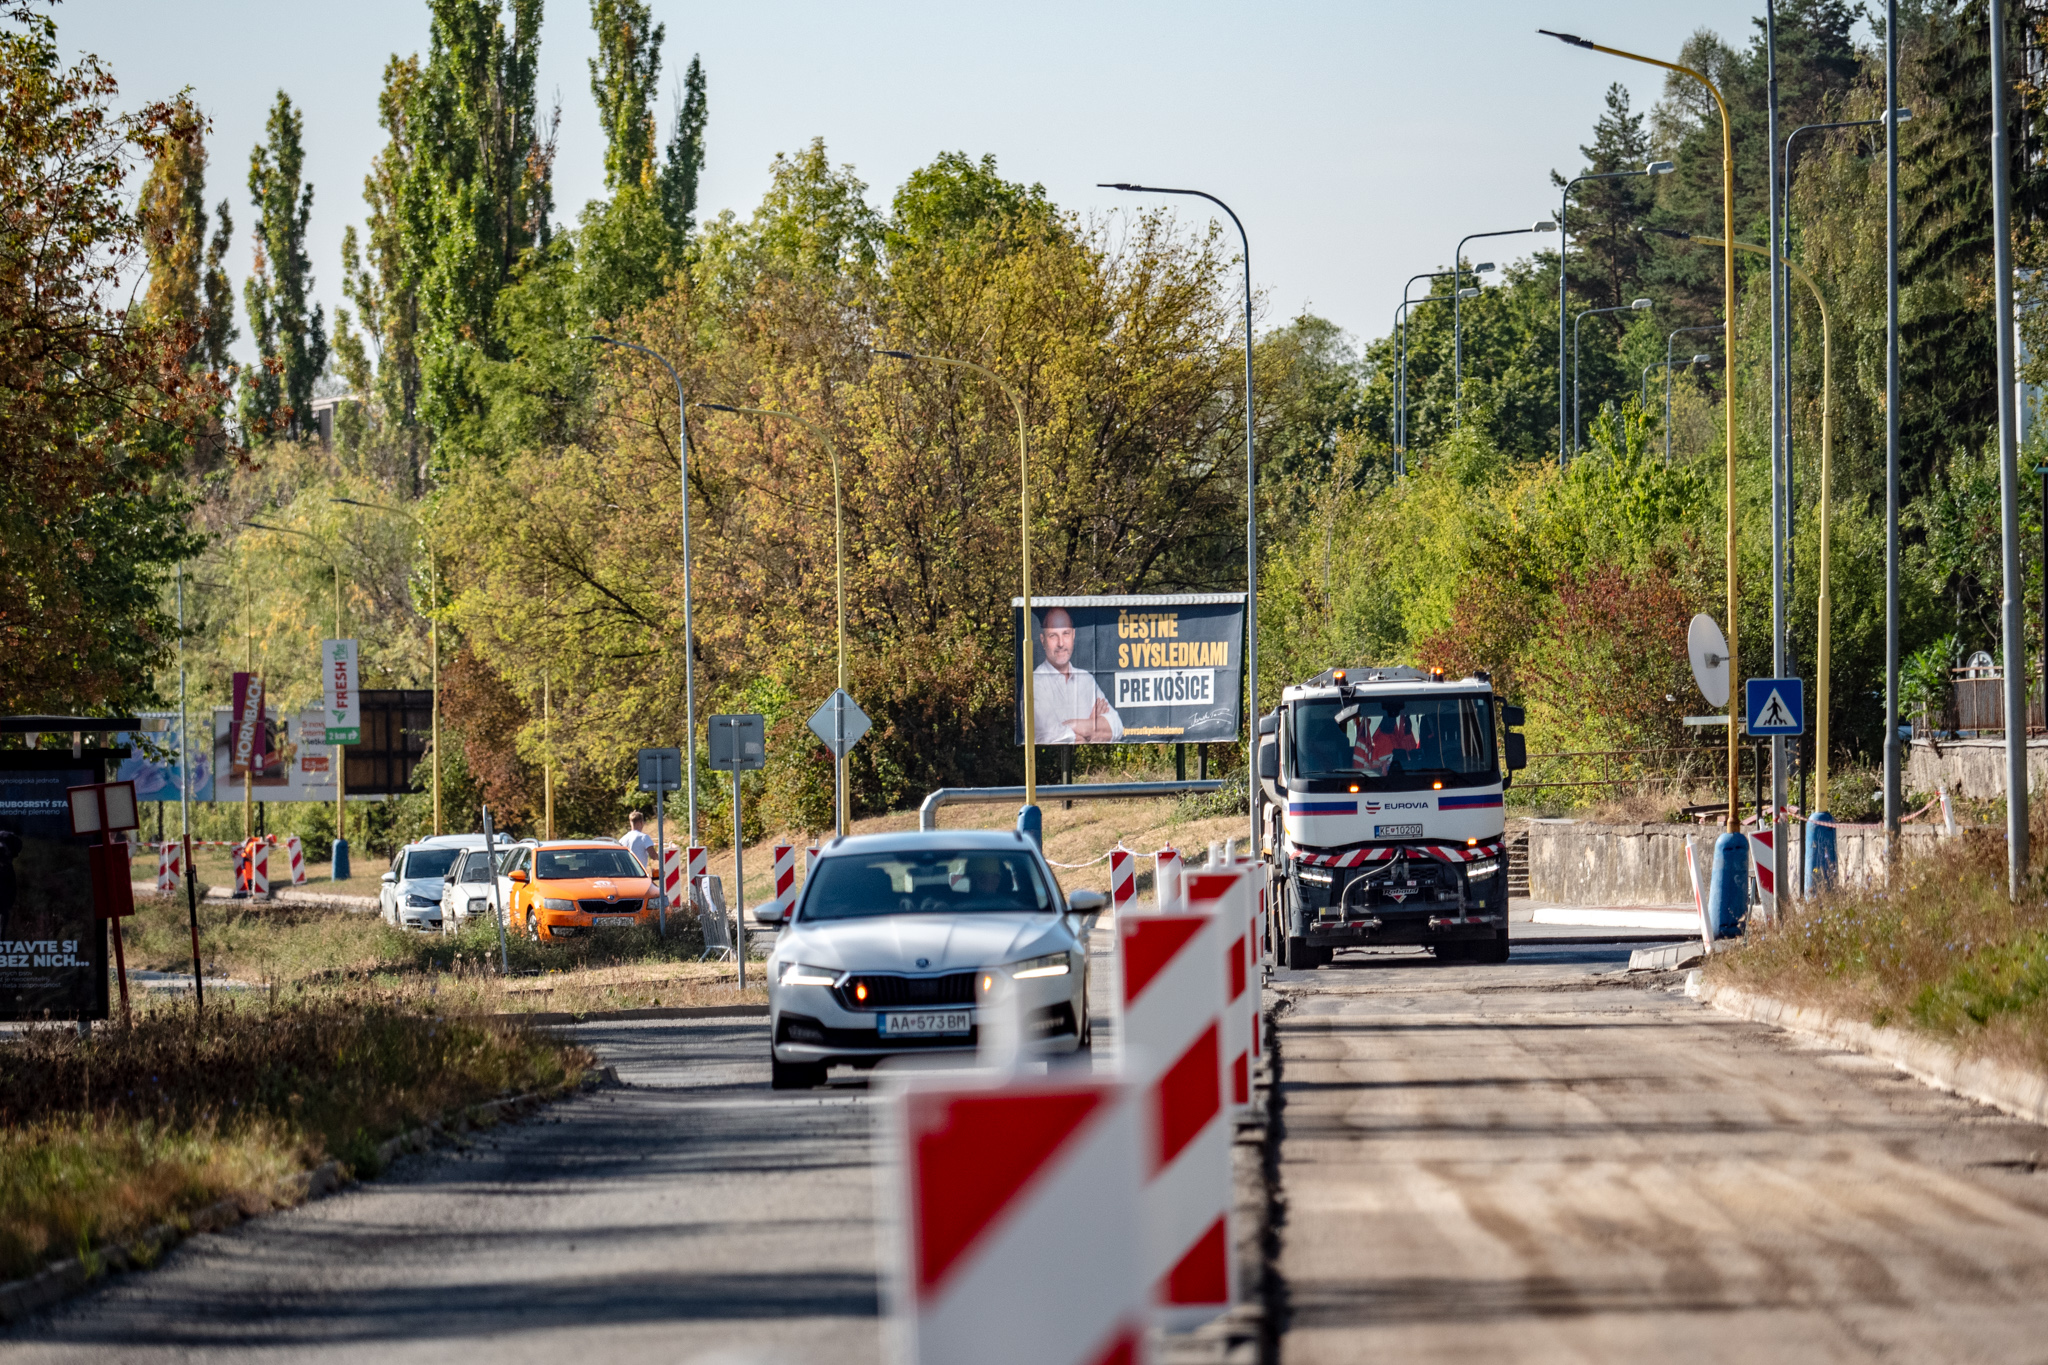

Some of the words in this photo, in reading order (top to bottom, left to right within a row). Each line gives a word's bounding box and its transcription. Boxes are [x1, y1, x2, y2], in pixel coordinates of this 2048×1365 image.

[1118, 609, 1178, 639] ČESTNE
[1118, 642, 1129, 668] S
[1131, 638, 1228, 668] VÝSLEDKAMI
[335, 661, 348, 708] FRESH
[1120, 677, 1150, 702] PRE
[1153, 671, 1209, 701] KOŠICE
[235, 676, 262, 765] HORNBACH
[329, 731, 334, 740] 2
[335, 731, 346, 740] km
[1384, 802, 1429, 810] EUROVIA
[1380, 826, 1391, 835] KE
[62, 940, 78, 953] SI
[0, 954, 29, 967] BEZ
[33, 954, 90, 967] NICH...
[890, 1016, 909, 1030] AA
[917, 1015, 966, 1030] 573BM
